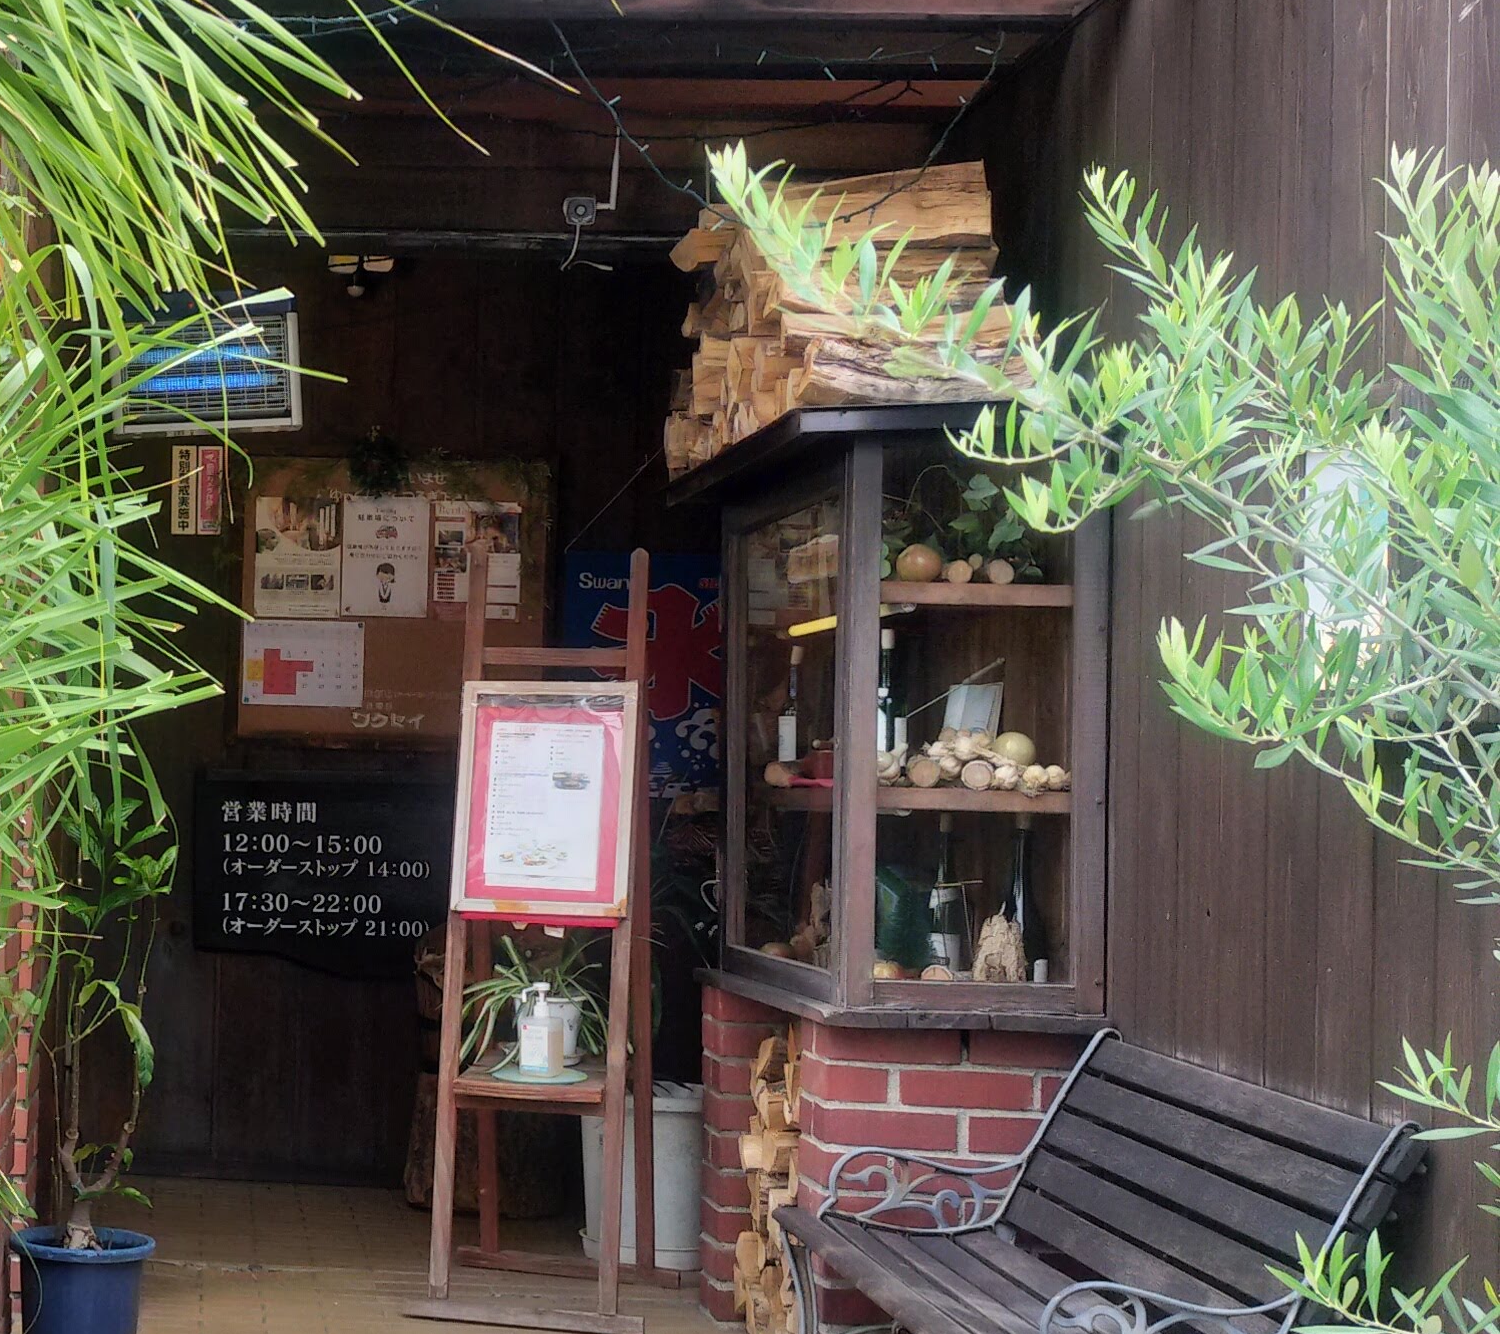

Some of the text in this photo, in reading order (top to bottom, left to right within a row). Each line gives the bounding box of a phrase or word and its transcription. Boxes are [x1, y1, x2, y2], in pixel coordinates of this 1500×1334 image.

[221, 800, 317, 823] 営業時間
[223, 857, 430, 878] (オーダーストップ 14:00)
[222, 917, 359, 937] (オーダーストップ
